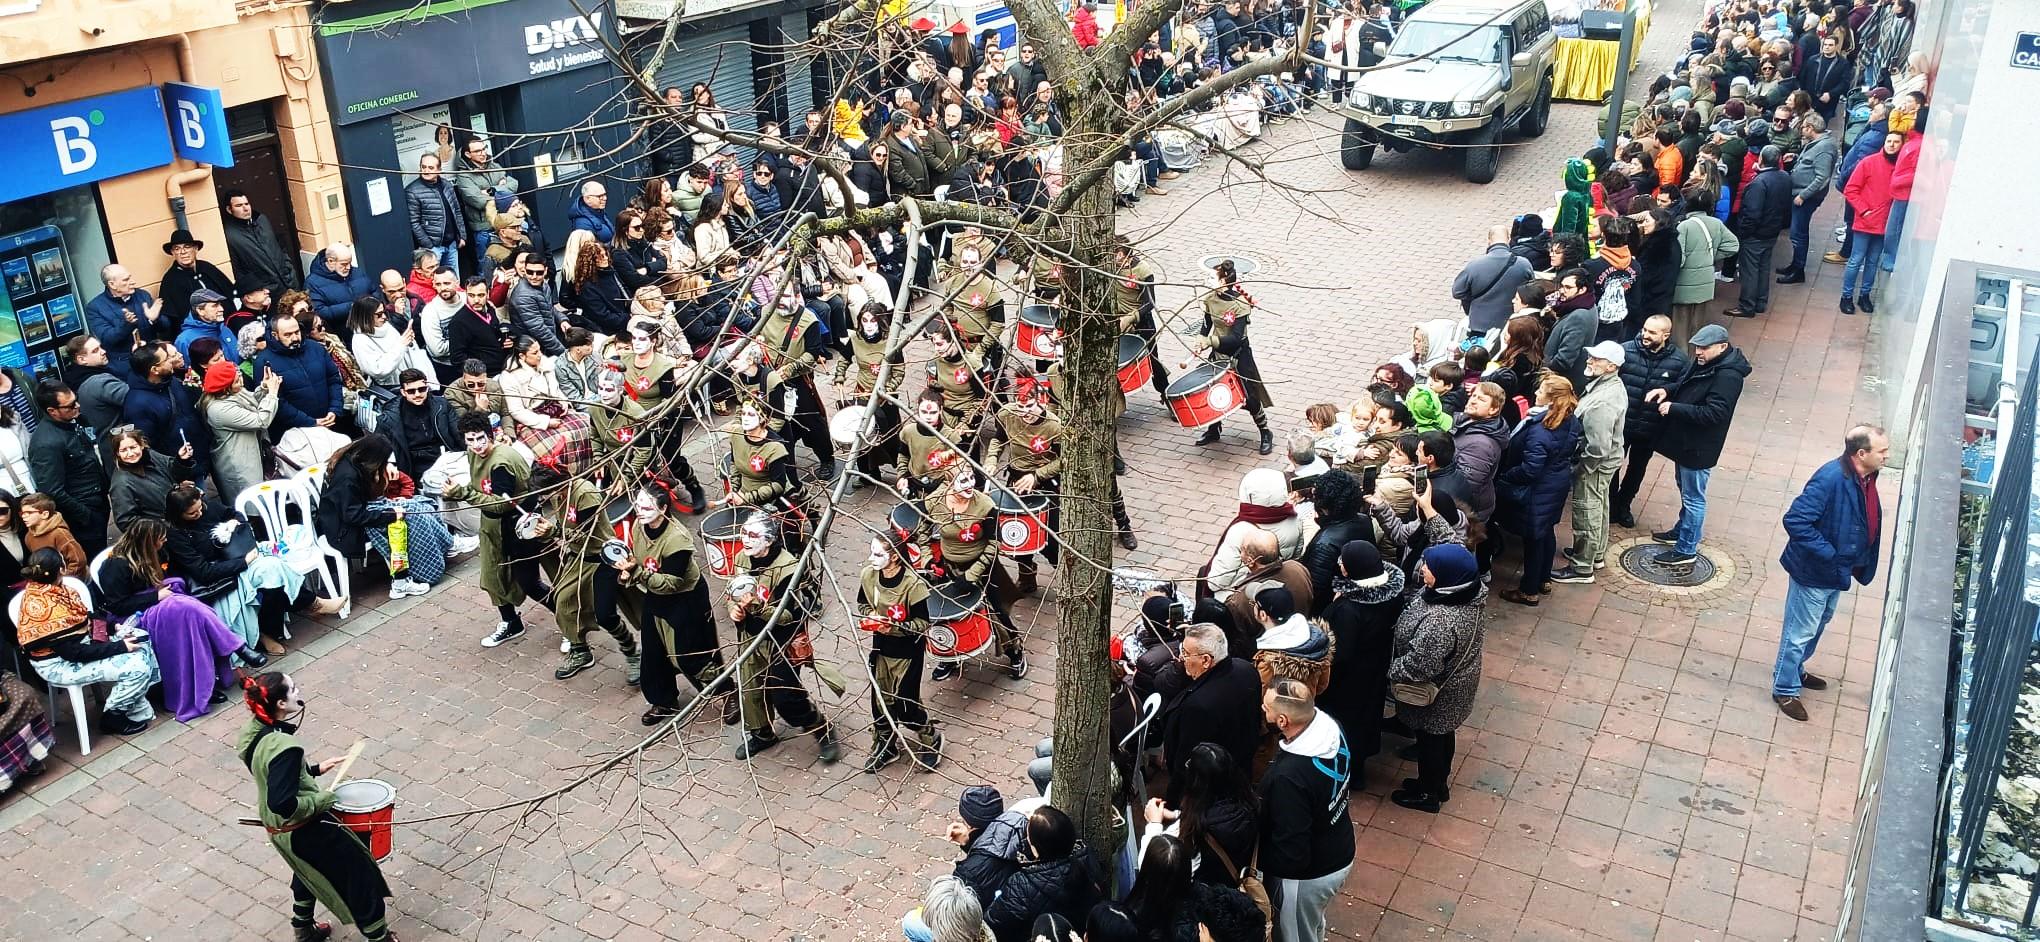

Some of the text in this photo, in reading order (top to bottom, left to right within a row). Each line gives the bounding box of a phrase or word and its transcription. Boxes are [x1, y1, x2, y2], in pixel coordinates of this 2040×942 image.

[524, 12, 602, 55] DKV
[529, 48, 605, 75] Salud y bienestar
[2016, 51, 2040, 65] CA
[347, 90, 419, 114] OFICINA COMERCIAL
[432, 109, 449, 119] DKV
[178, 99, 206, 149] B
[50, 116, 98, 176] B
